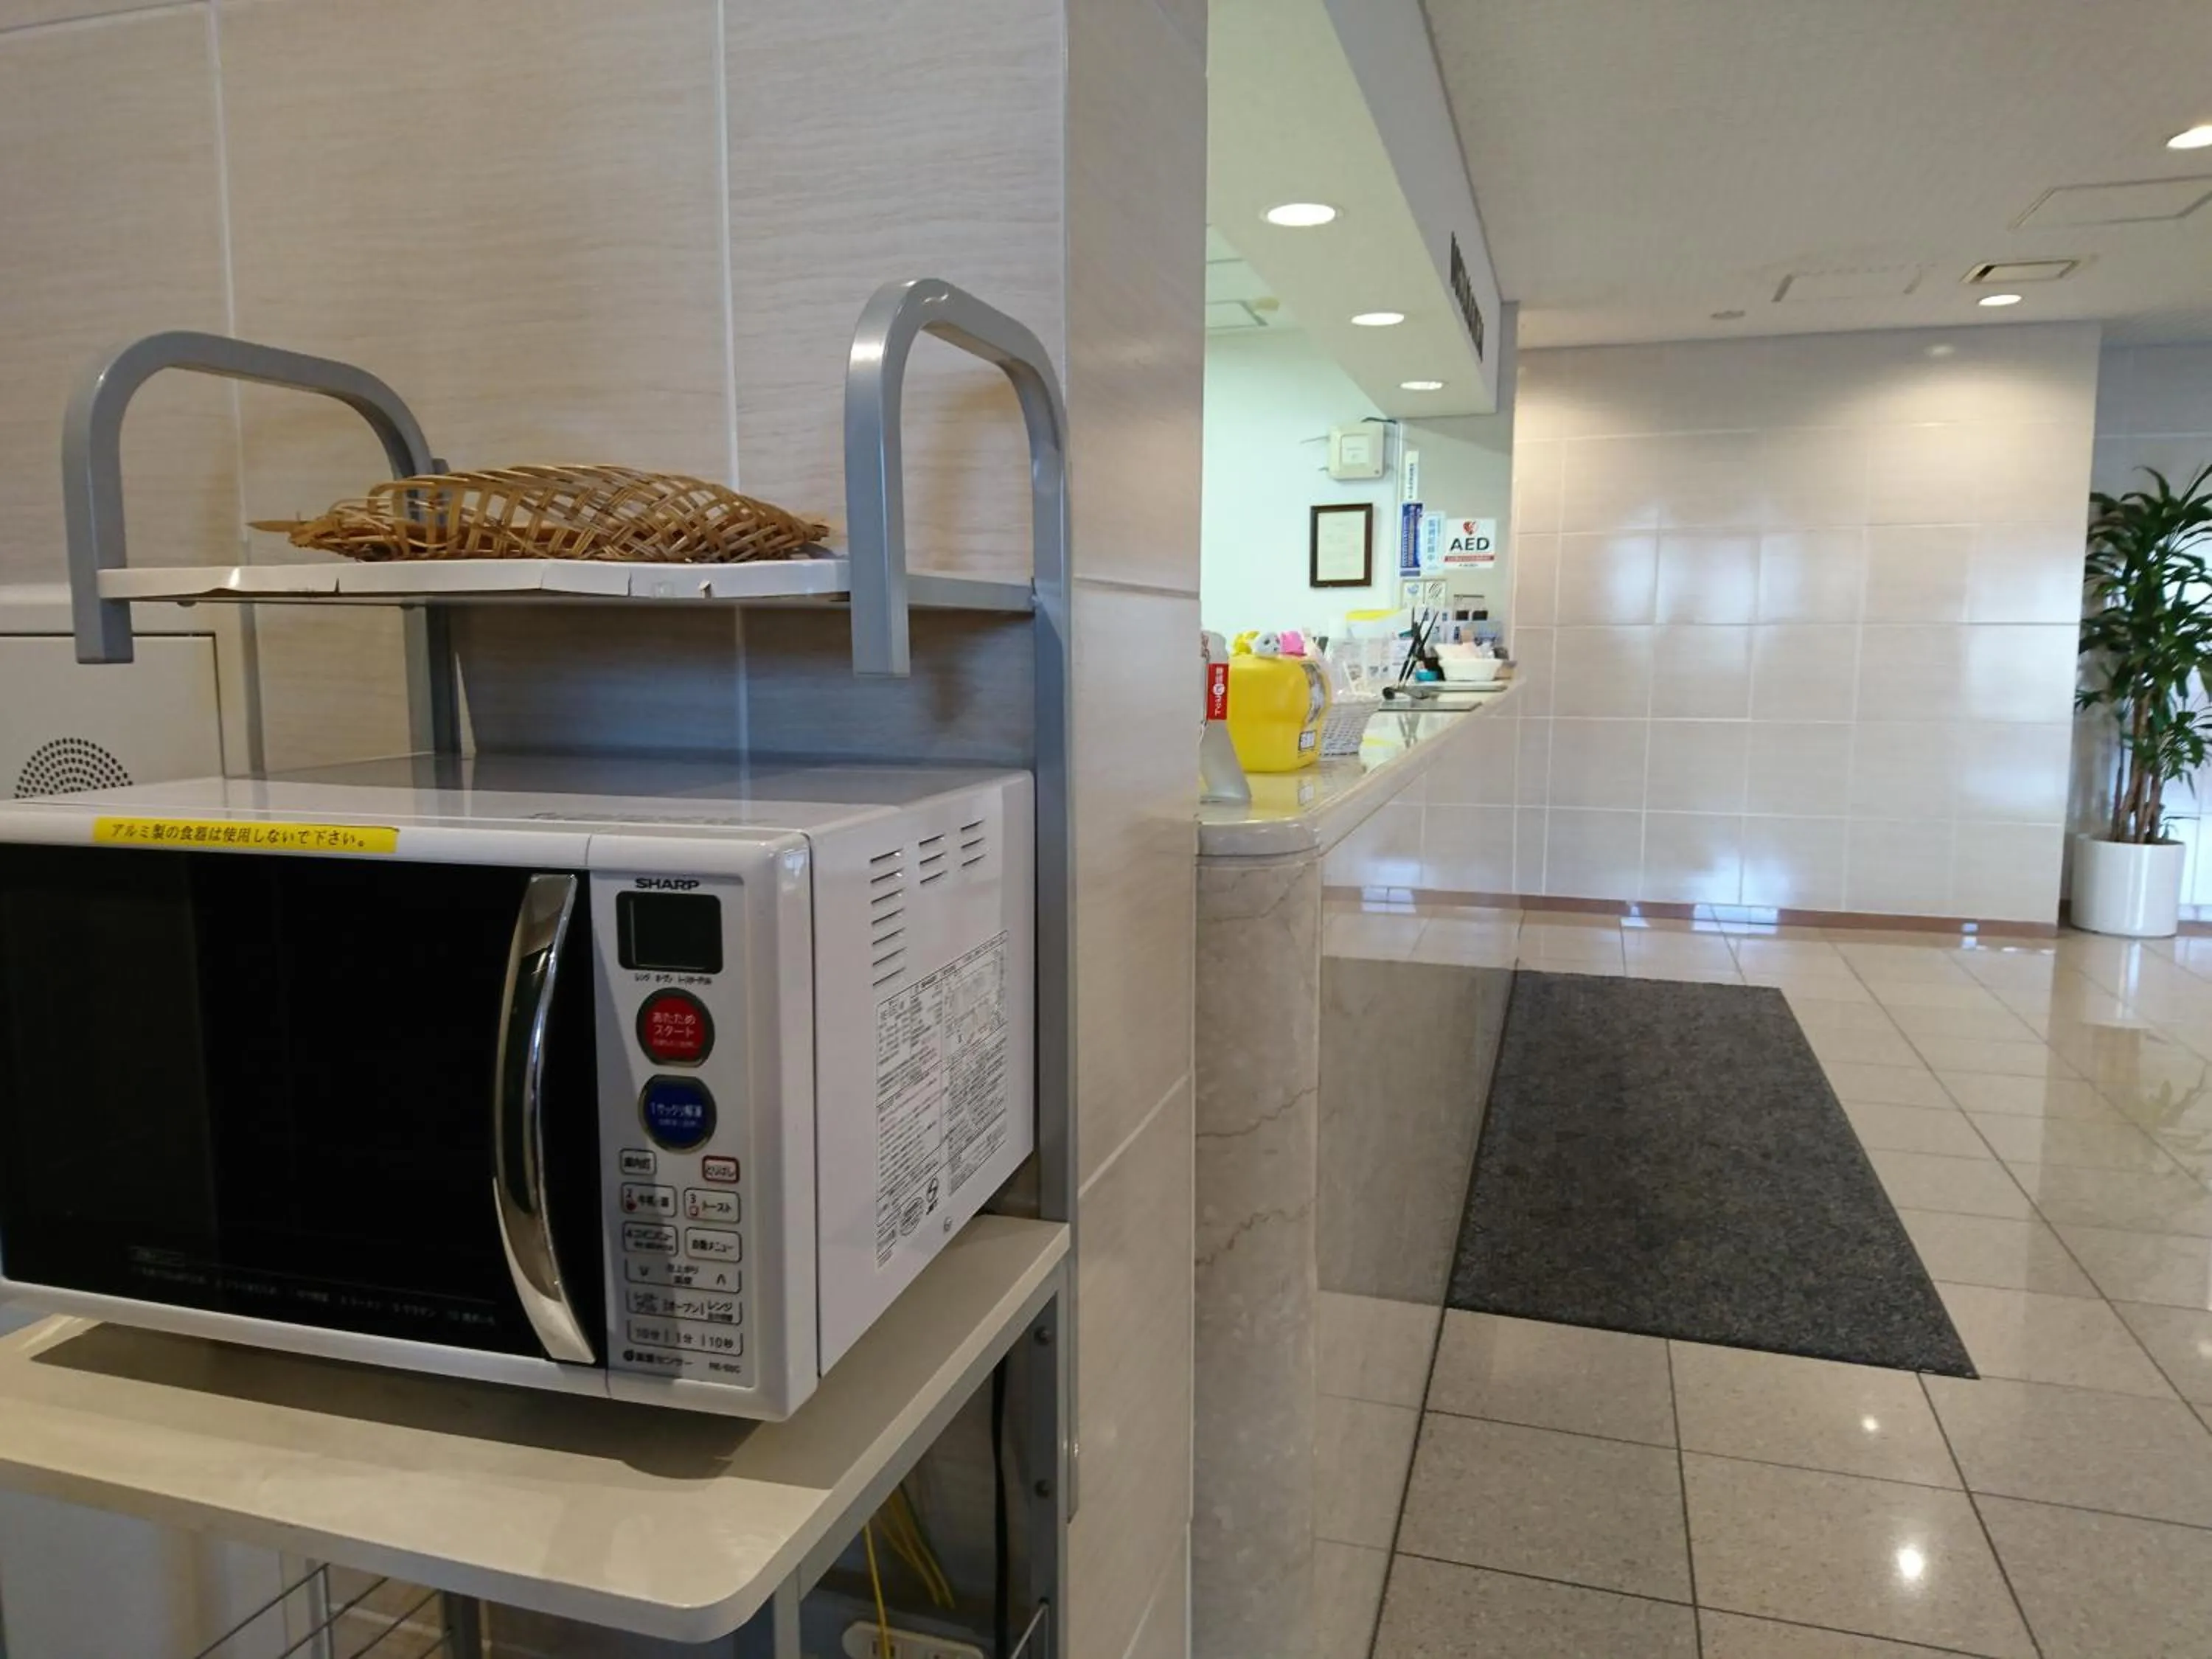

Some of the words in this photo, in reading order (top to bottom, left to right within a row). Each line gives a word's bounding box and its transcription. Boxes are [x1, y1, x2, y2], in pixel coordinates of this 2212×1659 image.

[1450, 537, 1490, 552] AED
[111, 824, 366, 847] アルミ製の食器は使用しないで下さい。
[635, 877, 700, 890] SHARP
[653, 1012, 697, 1025] あたため
[653, 1025, 695, 1038] スタート
[702, 1200, 732, 1213] トースト
[707, 1299, 733, 1311] レンジ
